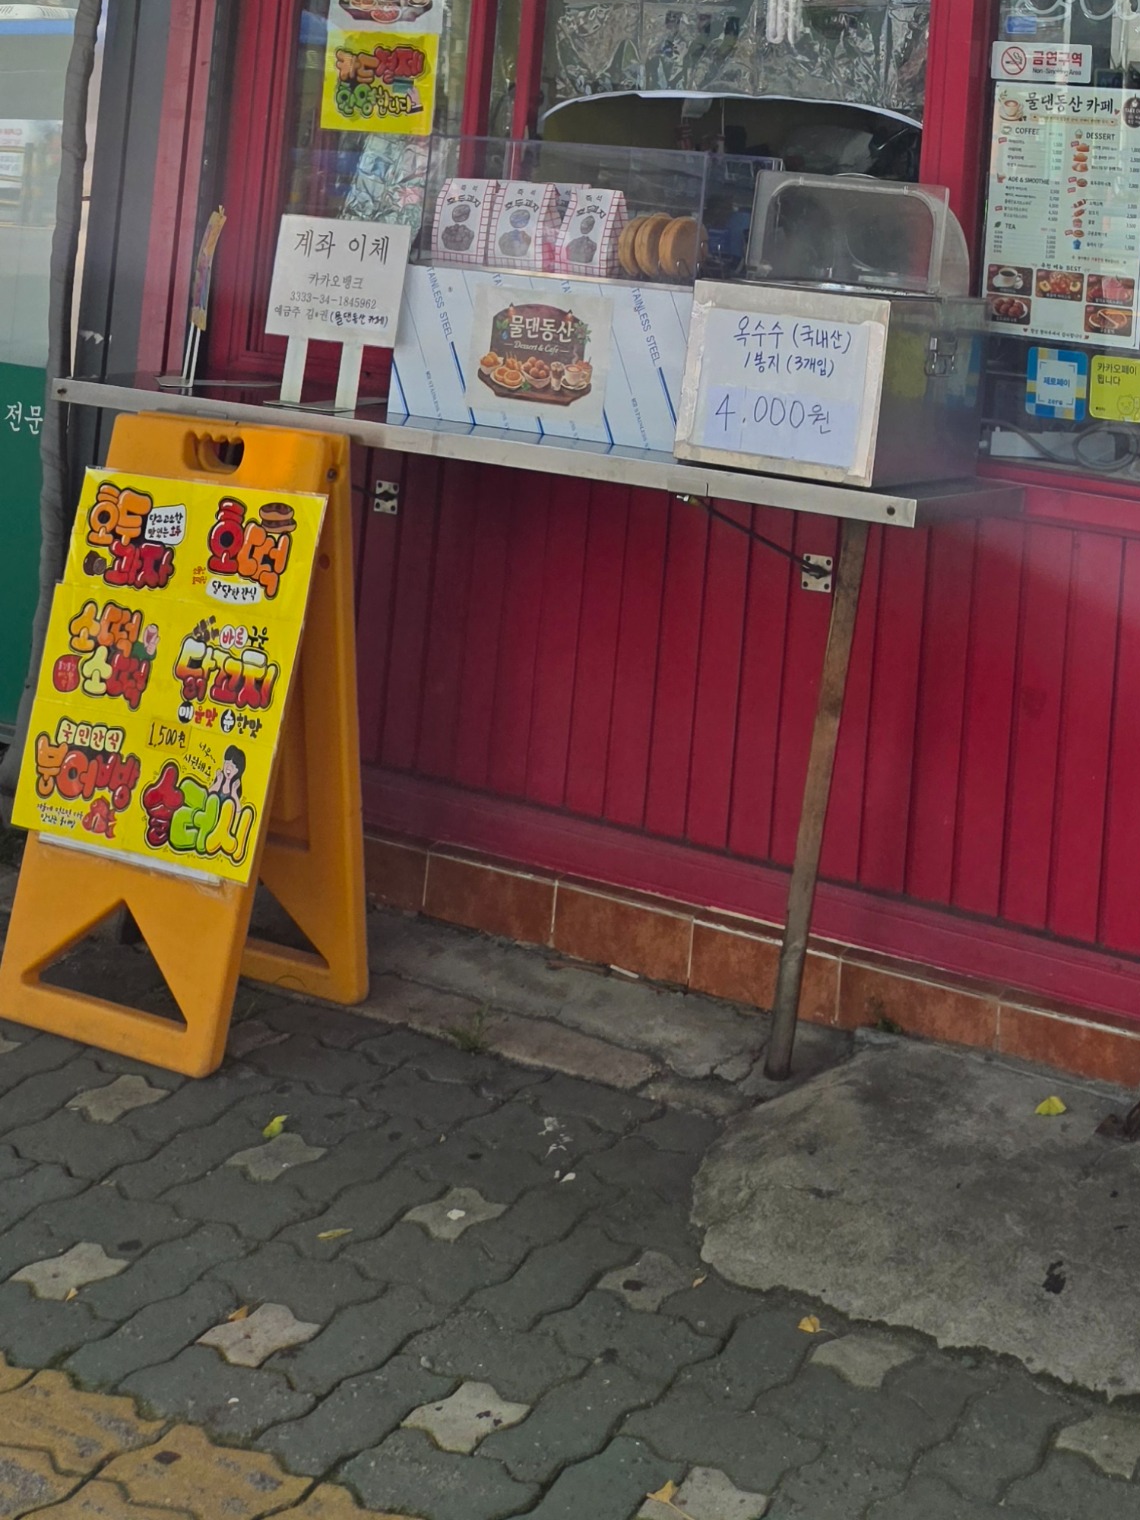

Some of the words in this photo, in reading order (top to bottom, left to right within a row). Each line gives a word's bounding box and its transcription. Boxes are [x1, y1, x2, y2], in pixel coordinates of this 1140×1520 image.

[1033, 51, 1082, 67] 금연구역
[1025, 92, 1083, 114] 물댄동산
[1086, 97, 1114, 114] 카페
[1086, 132, 1115, 140] DESSERT
[294, 229, 336, 259] 계좌
[348, 234, 389, 265] 이체
[308, 272, 364, 289] 카카오뱅크
[509, 315, 574, 343] 물댄동산
[733, 315, 784, 349] 옥수수
[793, 323, 851, 354] (국내산)
[514, 340, 538, 352] Dessert
[1043, 376, 1070, 388] 제로페이
[1097, 362, 1137, 376] 카카오페이
[1097, 374, 1121, 386] 됩니다
[5, 401, 43, 435] 전문
[87, 480, 153, 546] 호두
[207, 497, 292, 599] 호떡
[103, 540, 175, 590] 과자
[69, 600, 143, 658] 소떡
[220, 625, 248, 649] 바로
[248, 626, 269, 649] 구운
[82, 645, 151, 710] 소떡
[174, 634, 279, 709] 닭꼬치
[60, 720, 123, 751] 국민간식
[148, 722, 186, 749] 1,500원
[178, 701, 218, 727] 매운맛
[221, 709, 262, 738] 순한맛
[35, 731, 140, 811] 붕어빵
[143, 761, 255, 865] 슬러시
